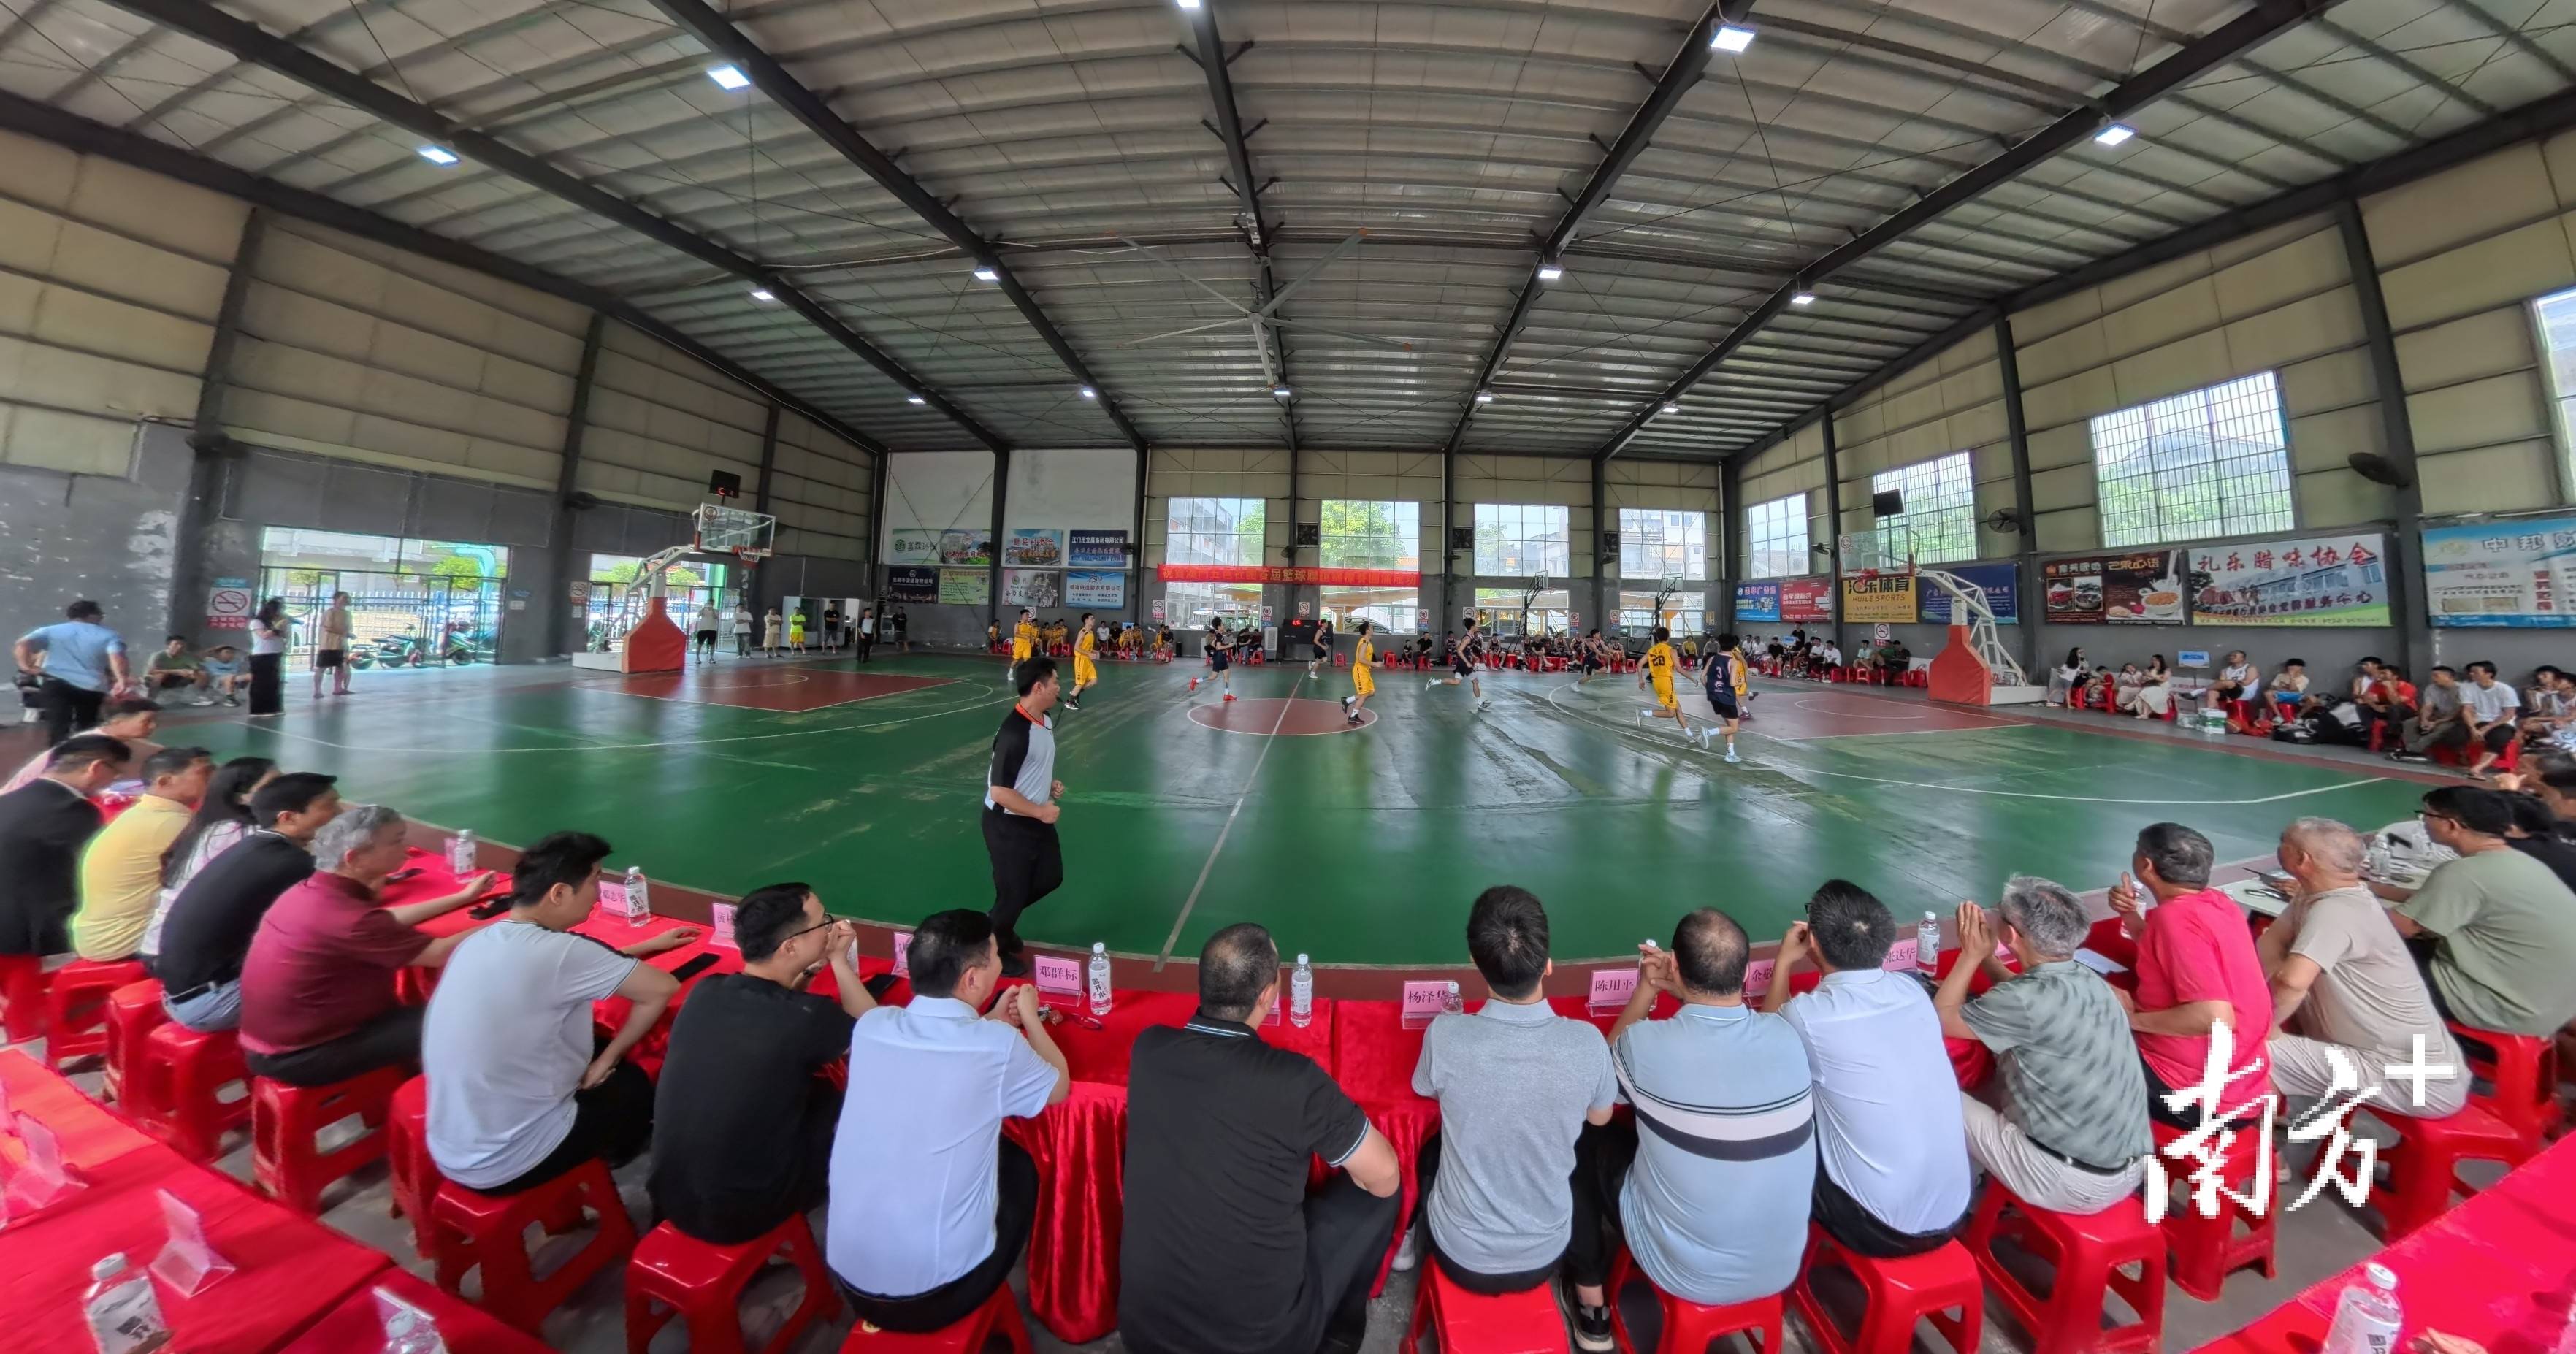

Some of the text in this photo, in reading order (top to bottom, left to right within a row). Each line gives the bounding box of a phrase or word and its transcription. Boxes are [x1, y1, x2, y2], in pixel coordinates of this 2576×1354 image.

[2198, 542, 2377, 573] 礼乐腊味协会
[1875, 594, 1906, 602] SPORTS
[1716, 665, 1723, 679] 3
[1039, 965, 1078, 981] 邓群标
[1594, 979, 1635, 992] 陈用平
